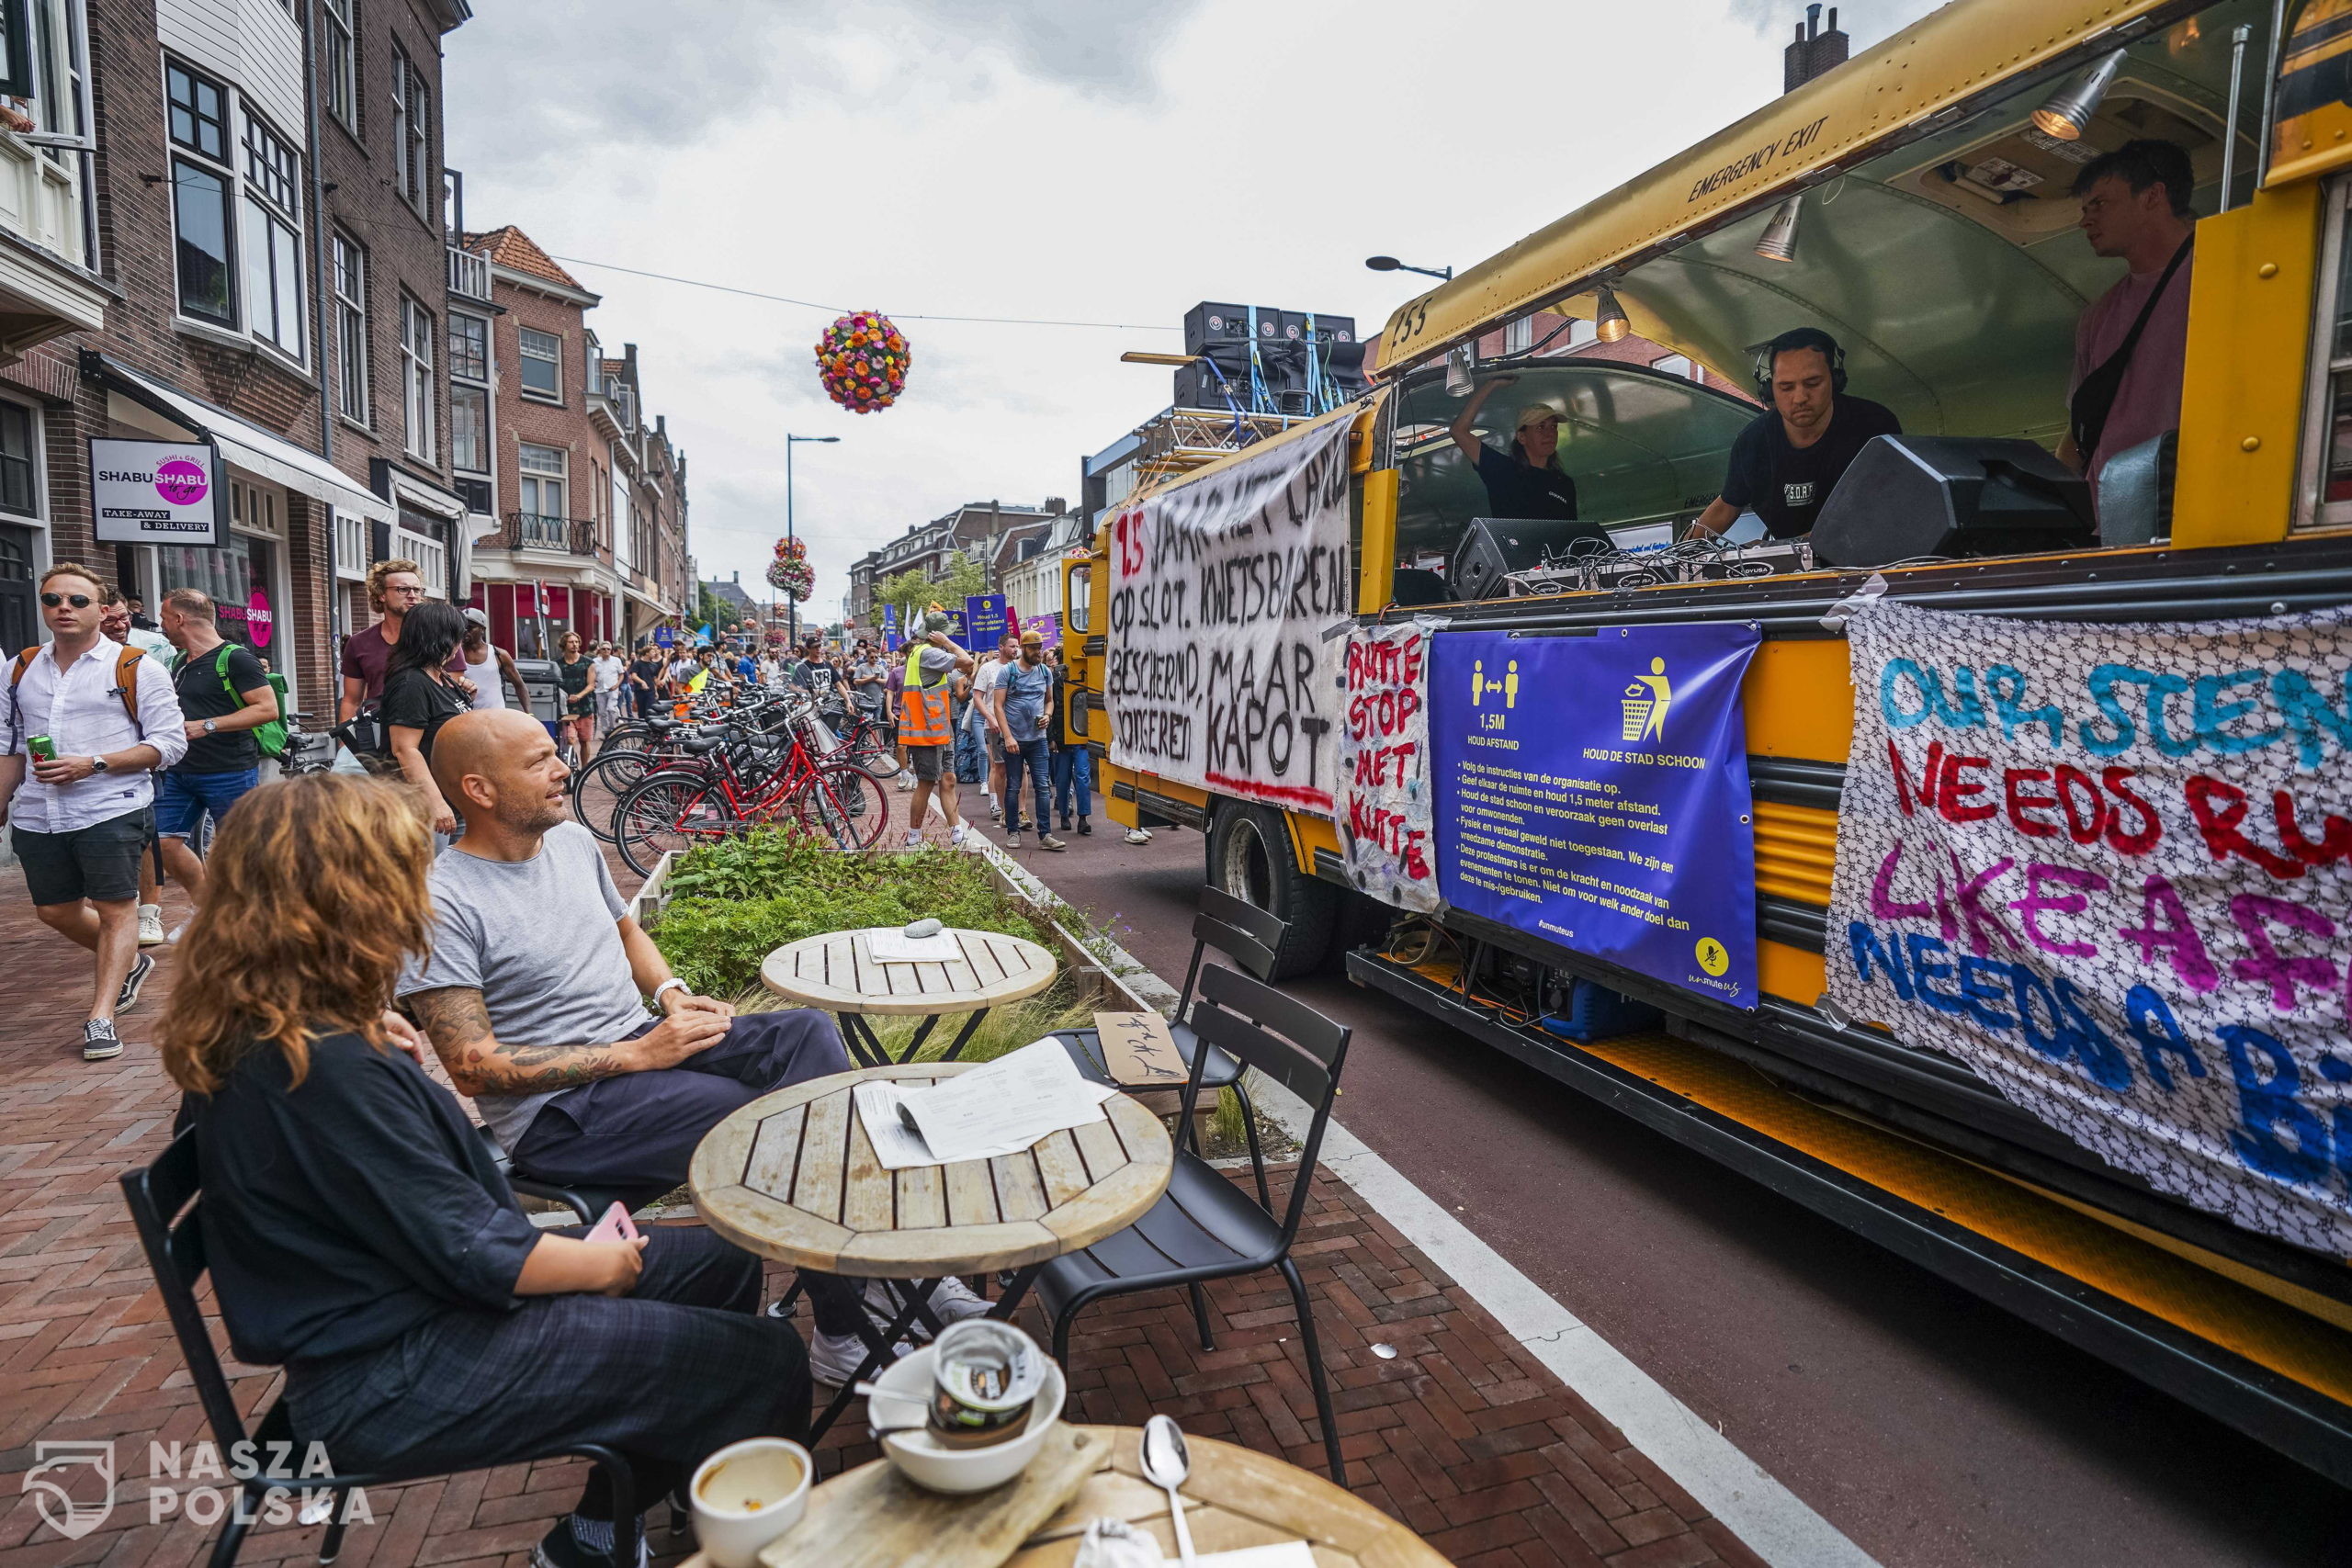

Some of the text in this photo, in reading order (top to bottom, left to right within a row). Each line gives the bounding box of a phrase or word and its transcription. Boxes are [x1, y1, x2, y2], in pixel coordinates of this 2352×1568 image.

[1688, 115, 1829, 203] EMERGENCY EXIT
[98, 470, 208, 486] SHABU SHABU
[155, 455, 177, 468] SUSHI
[185, 456, 204, 468] GRILL
[104, 509, 168, 519] TAKE-AWAY
[154, 522, 208, 531] DELIVERY
[219, 605, 271, 622] SHABU SHABU
[1207, 641, 1315, 715] MAAR
[1349, 633, 1421, 692] RUTTE
[1350, 688, 1417, 741] STOP
[1479, 713, 1505, 732] 1,5M
[1879, 658, 2063, 750] OUR
[1206, 698, 1330, 787] KAPOT
[1355, 742, 1416, 789] MET
[1467, 735, 1519, 750] HOUD AFSTAND
[1583, 747, 1706, 770] HOUD DE STAD SCHOON
[1461, 774, 1661, 816] Geef elkaar de ruimte en houd 1,5 meter afstand.
[1463, 760, 1621, 795] Volg de instructies van de organisatie op.
[1887, 739, 2162, 857] NEEDS
[1350, 790, 1430, 880] KUTTE
[1461, 788, 1668, 835] Houd de stad schoon en veroorzaak geen overlast
[1461, 804, 1525, 825] voor omwonenden.
[1460, 816, 1673, 874] Fysiek en verbaal geweld niet toegestaan. We zijn een
[1460, 831, 1548, 861] vreedzame demonstratie.
[1460, 843, 1669, 909] Deze protestmars is er om de kracht en noodzaak van
[1460, 871, 1543, 904] deze te mis-/gebruiken.
[1460, 859, 1690, 931] evenementen te tonen. Niet om voor welk ander doel dan
[1538, 919, 1574, 937] #unmuteus
[2117, 874, 2221, 993] A
[2231, 893, 2352, 1021] F
[1849, 920, 2132, 1092] NEEDS
[2124, 984, 2205, 1094] A
